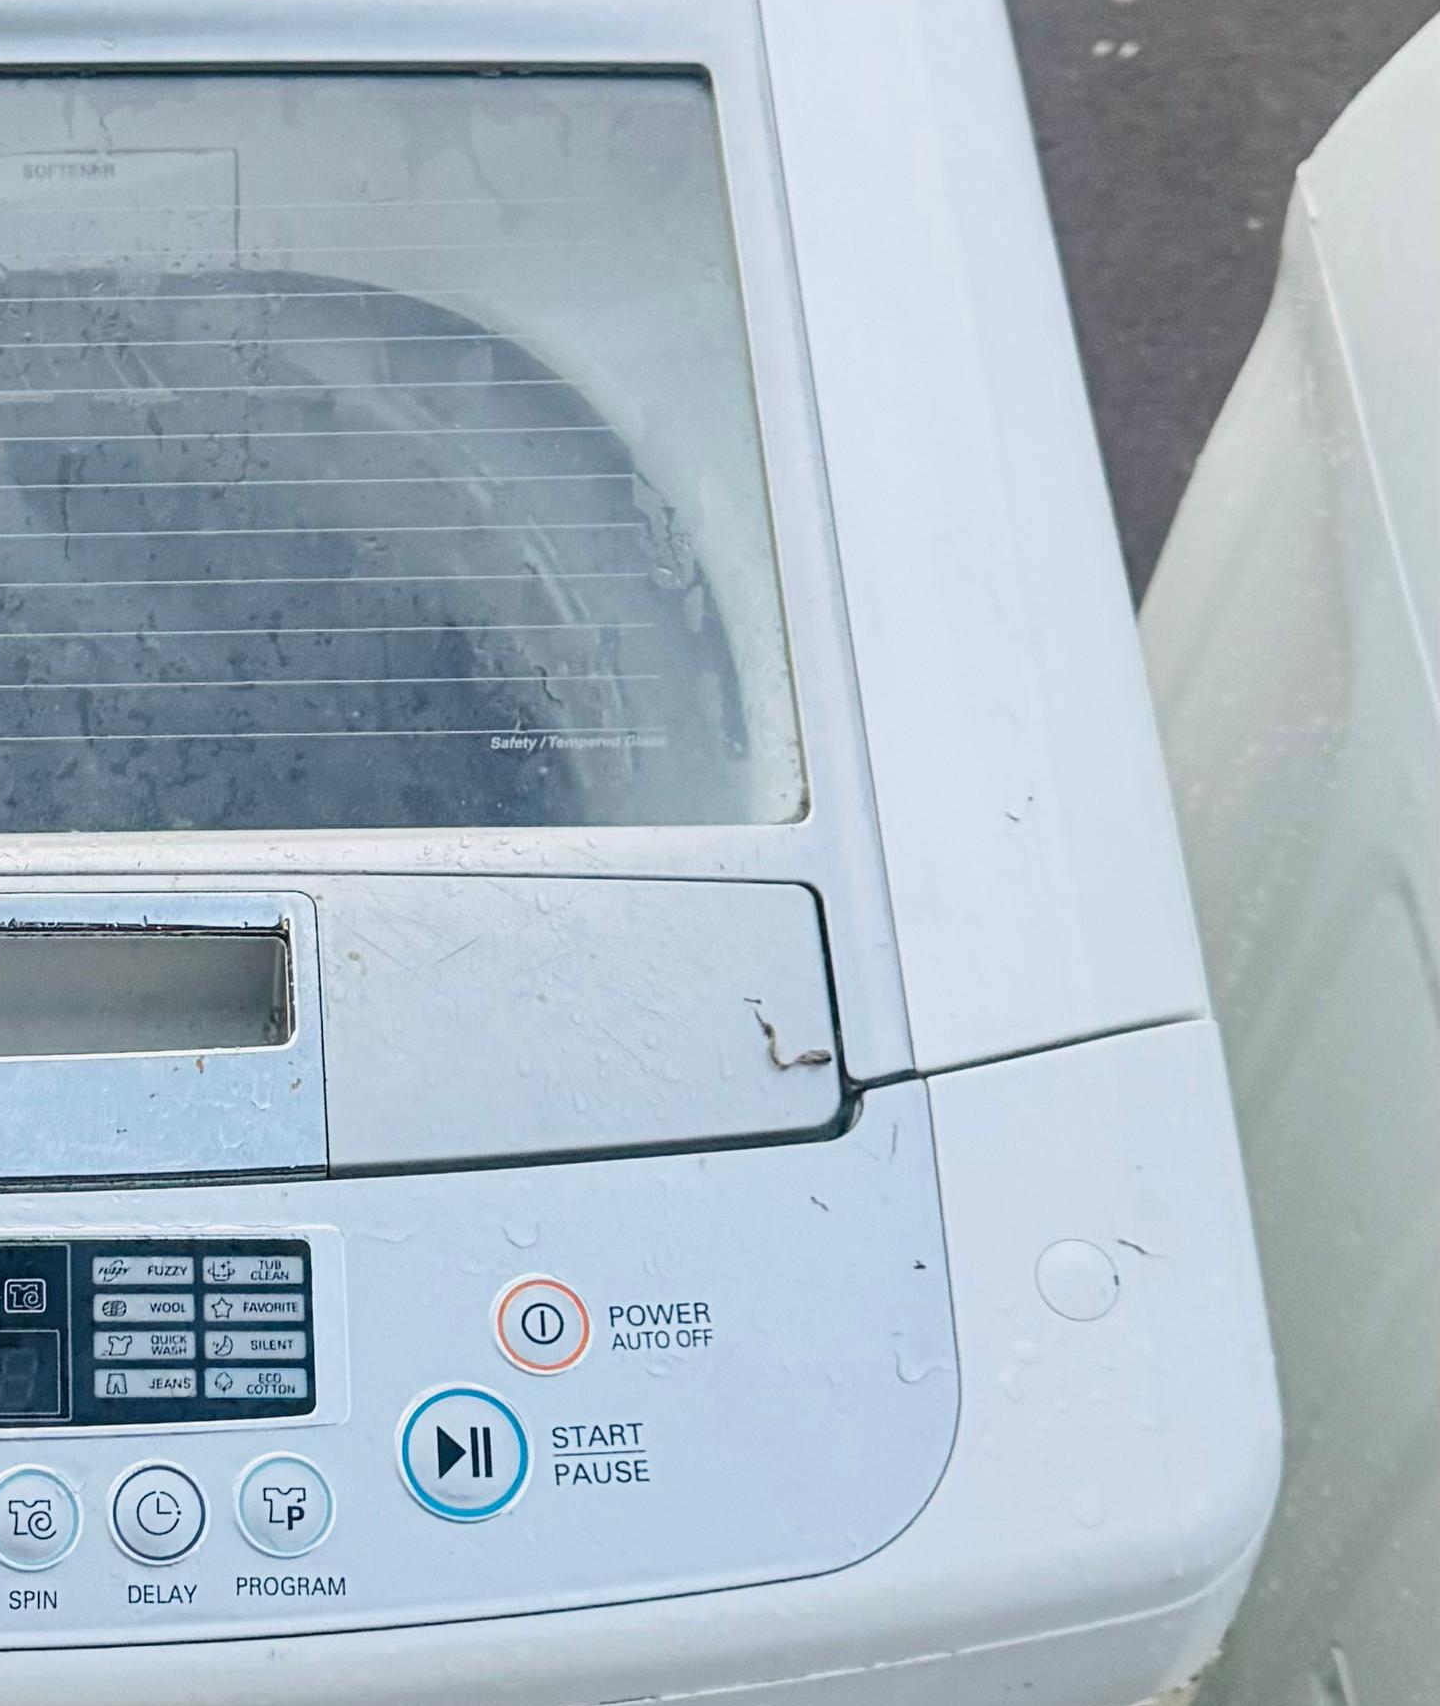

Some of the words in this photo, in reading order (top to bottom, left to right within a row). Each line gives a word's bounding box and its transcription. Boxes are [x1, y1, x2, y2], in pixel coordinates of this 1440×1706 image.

[490, 735, 537, 754] Safety
[147, 1266, 188, 1277] FUZZY
[258, 1259, 282, 1271] TUB
[250, 1271, 289, 1281] CLEAN
[150, 1302, 187, 1313] WOOL
[242, 1301, 299, 1314] FAVORITE
[609, 1302, 712, 1328] POWER
[150, 1334, 188, 1345] QUICK
[250, 1339, 294, 1351] SILENT
[611, 1329, 671, 1352] AUTO
[676, 1328, 714, 1348] OFF
[150, 1345, 188, 1356] WASH
[148, 1377, 193, 1390] JEANS
[258, 1372, 282, 1384] ECO
[246, 1383, 297, 1395] COTTON
[550, 1422, 644, 1449] START
[553, 1459, 651, 1486] PAUSE
[235, 1575, 347, 1597] PROGRAM
[8, 1589, 59, 1610] SPIN
[127, 1583, 198, 1605] DELAY
